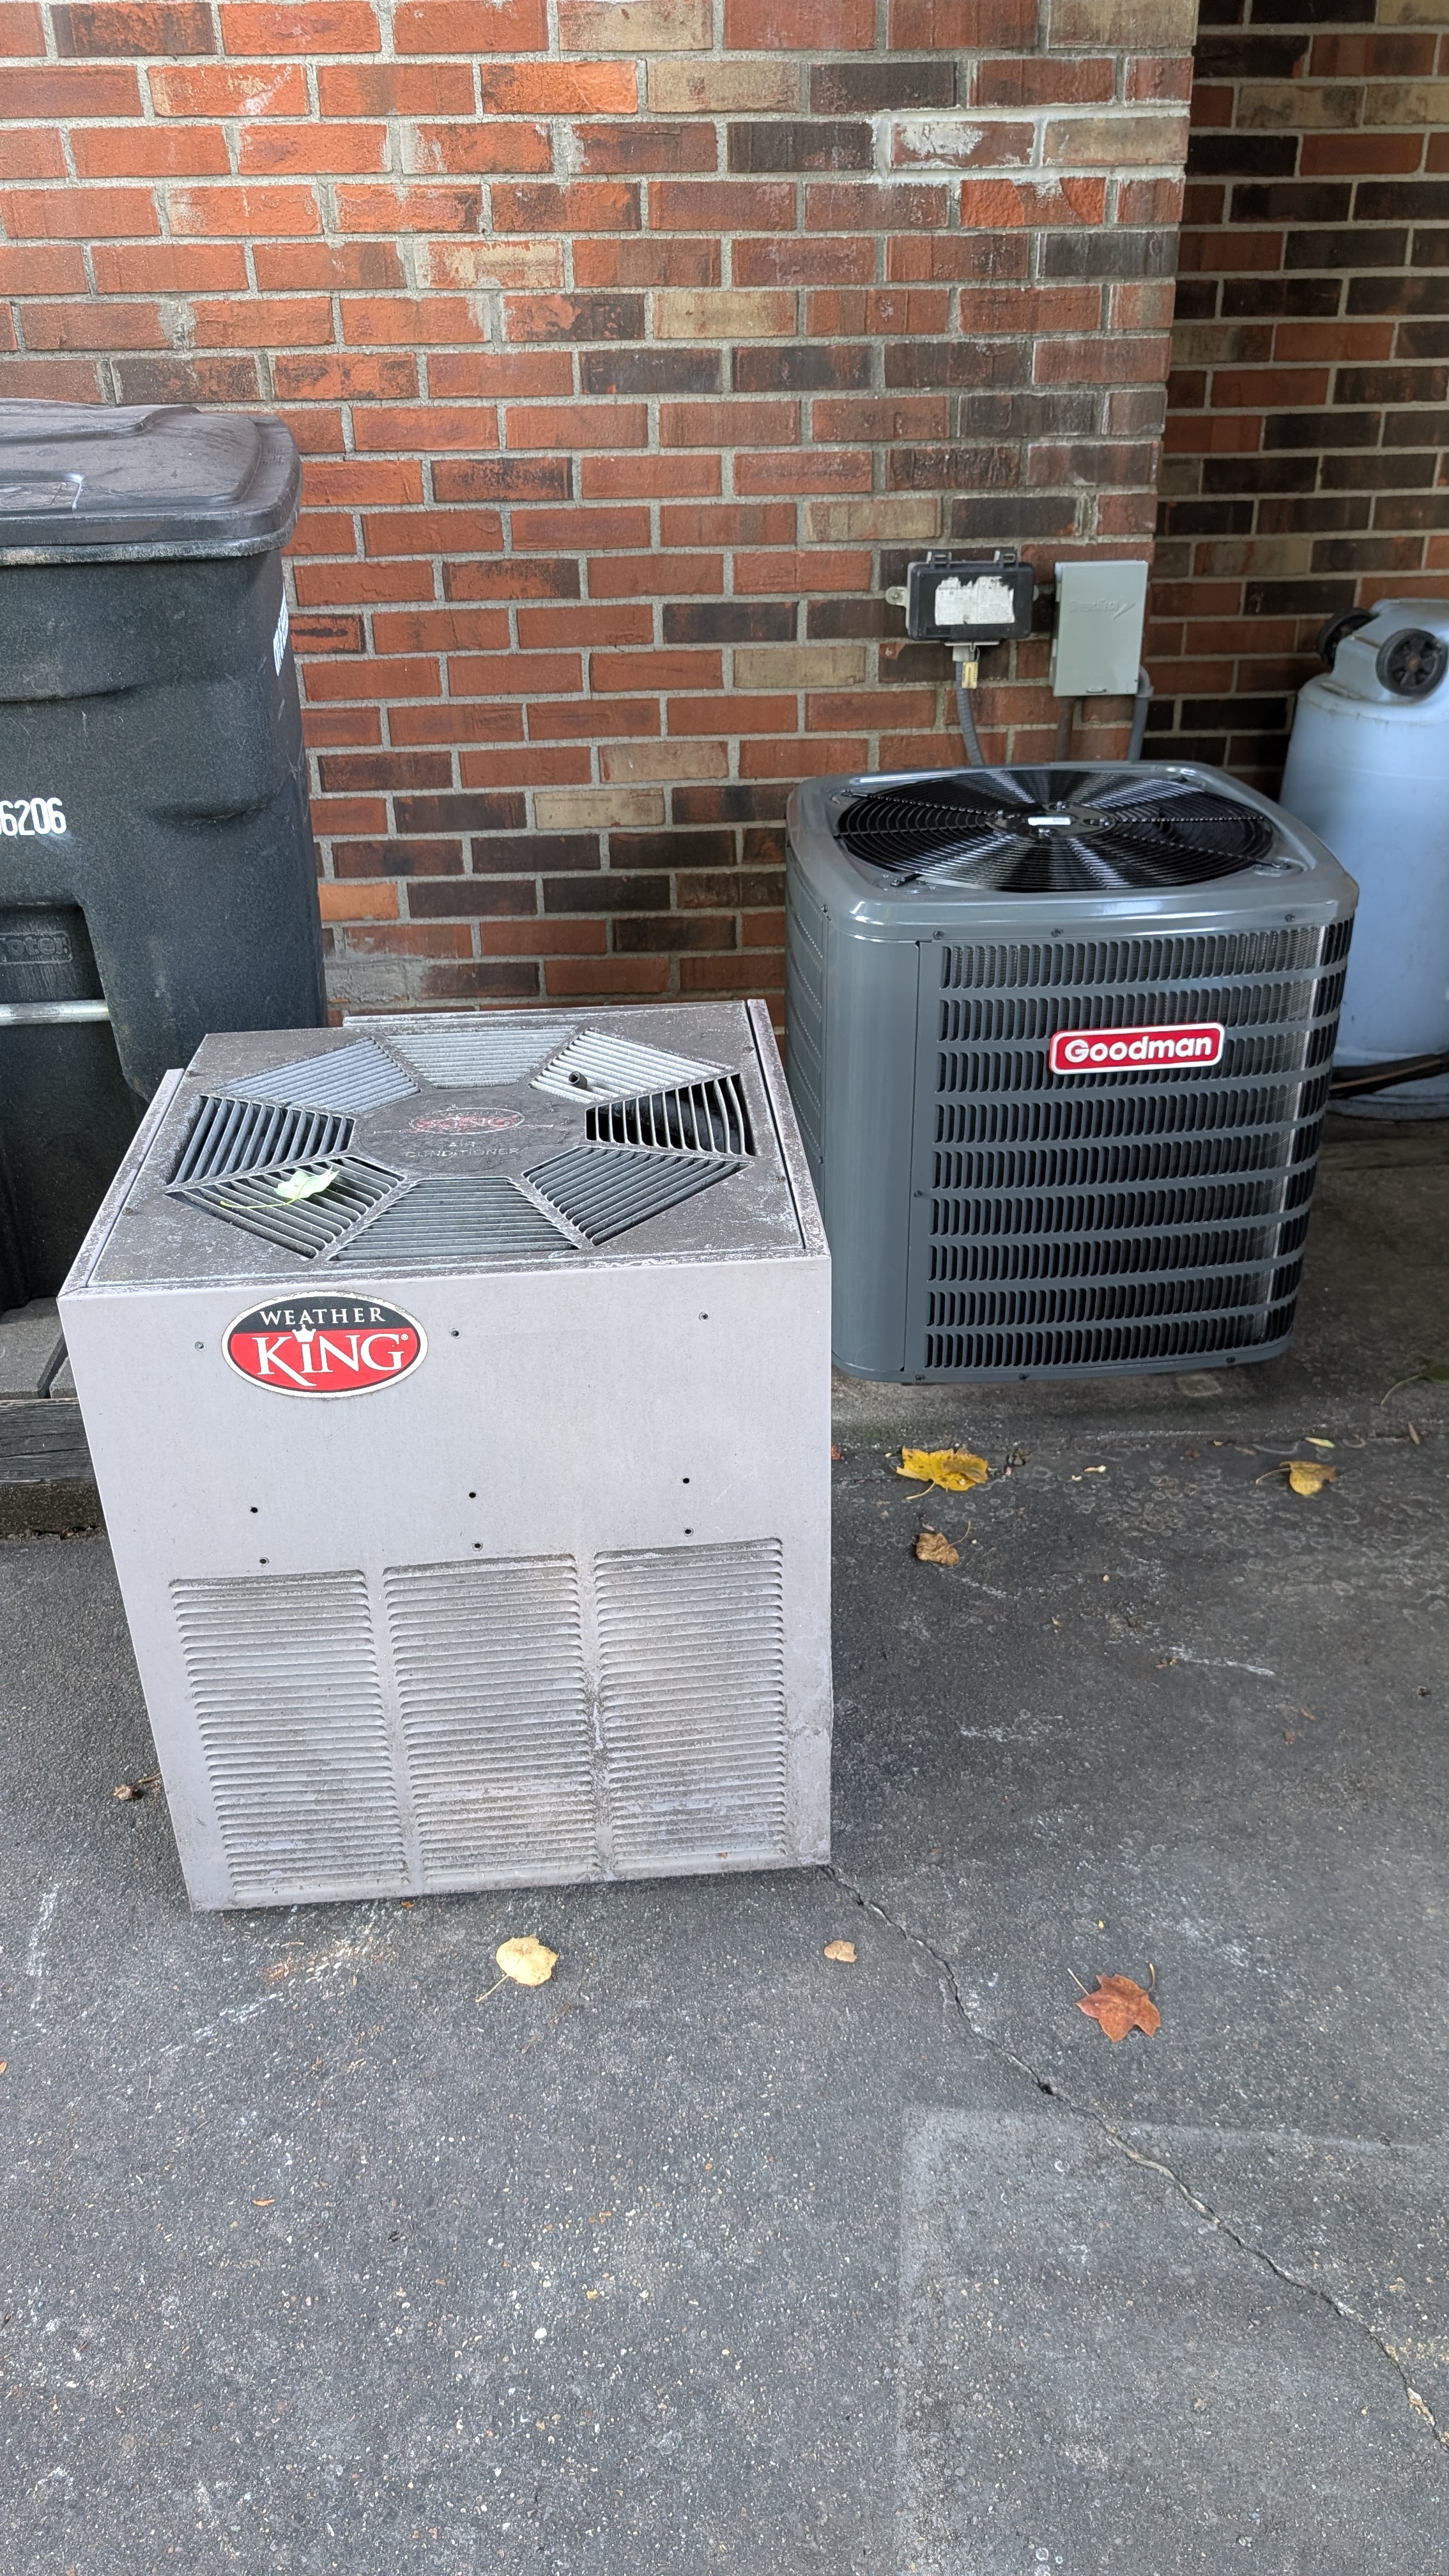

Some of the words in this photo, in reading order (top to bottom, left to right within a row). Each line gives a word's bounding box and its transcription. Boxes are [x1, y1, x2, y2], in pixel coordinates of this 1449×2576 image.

[0, 797, 66, 836] 6206
[1064, 1035, 1212, 1063] Goodman
[258, 1307, 386, 1326] WEATHER
